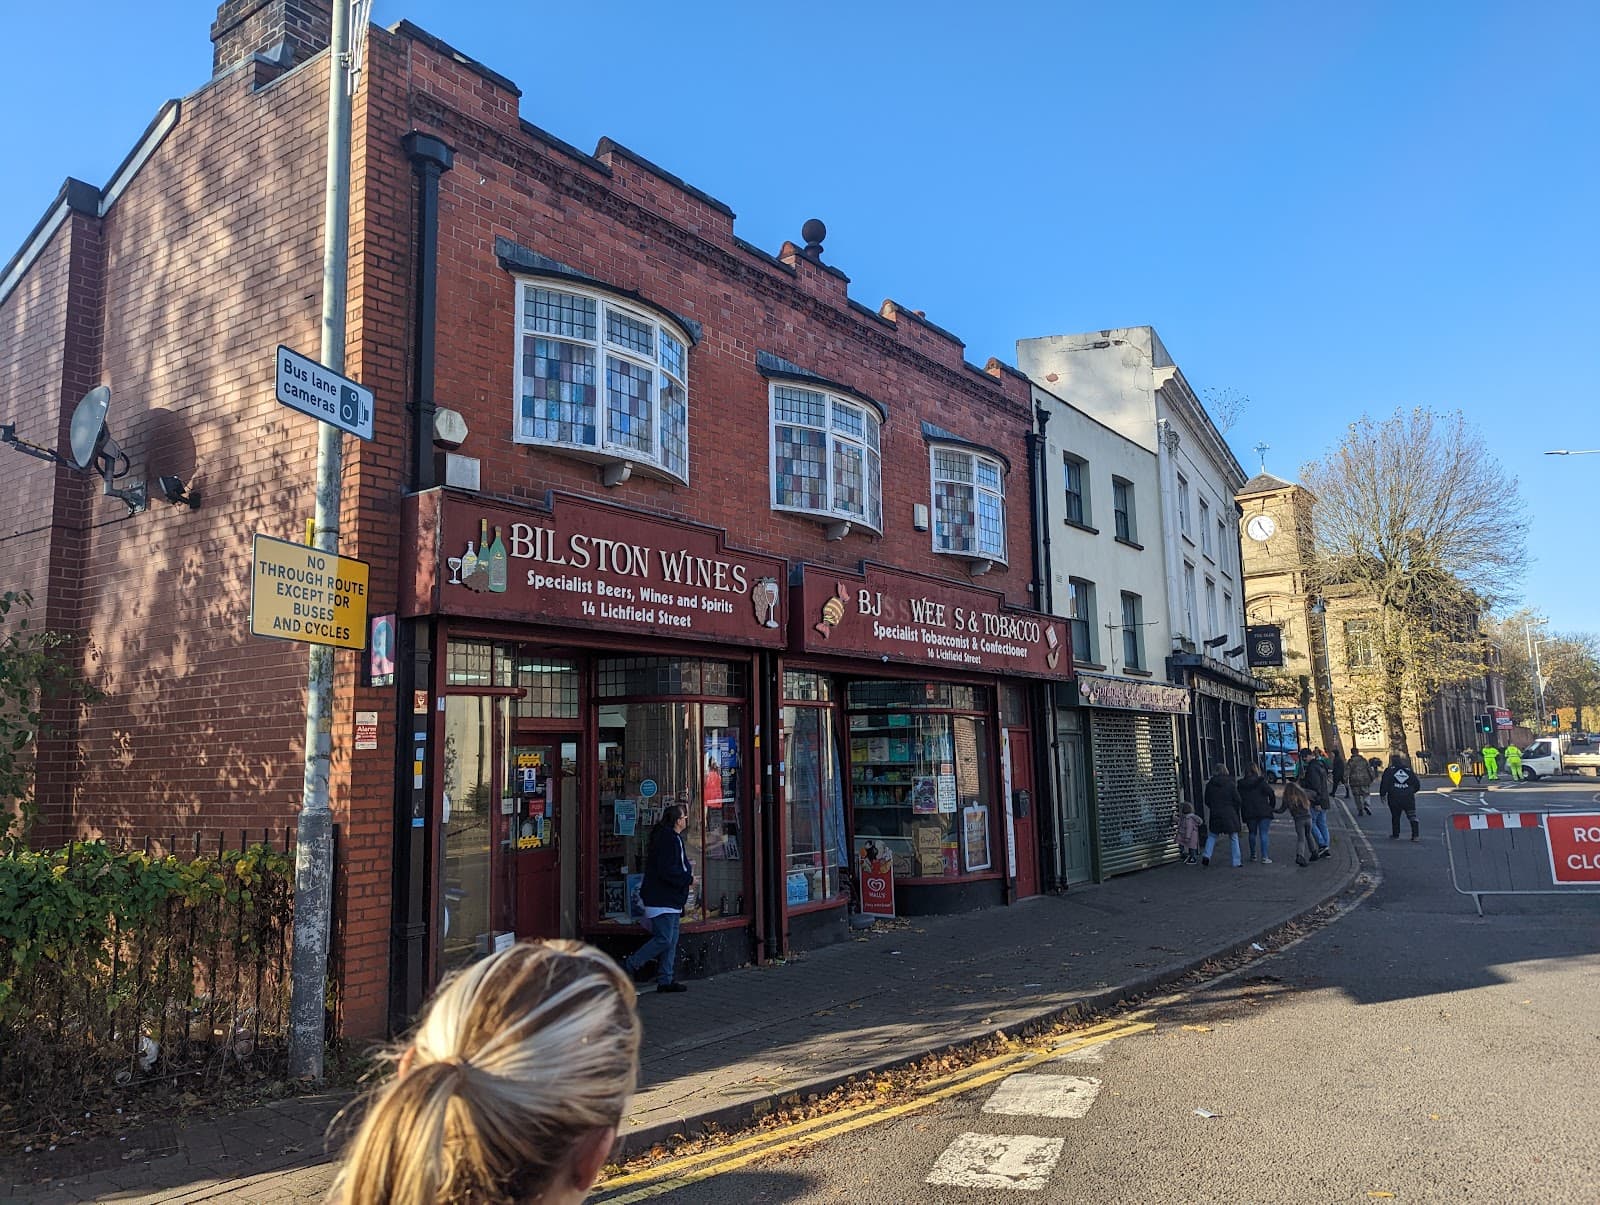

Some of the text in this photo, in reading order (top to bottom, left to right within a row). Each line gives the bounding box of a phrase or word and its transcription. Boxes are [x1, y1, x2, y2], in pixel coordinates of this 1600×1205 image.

[283, 358, 337, 396] Bus lane
[283, 382, 336, 414] cameras
[307, 555, 325, 571] NO
[510, 523, 748, 594] BILSTON WINES
[259, 560, 365, 596] THROUGH ROUTE
[527, 569, 733, 613] Specialist Beers, Wines and Spirits
[276, 582, 350, 609] EXCEPT FOR
[273, 615, 350, 641] AND CYCLES
[293, 603, 335, 622] BUSES
[581, 601, 692, 628] 14 Lichfield Street
[967, 610, 979, 633] &
[982, 613, 1040, 644] TOBACCO
[873, 620, 1028, 658] Specialist Tobacconist & Confectioner
[927, 647, 981, 665] 16 Lichfield Street
